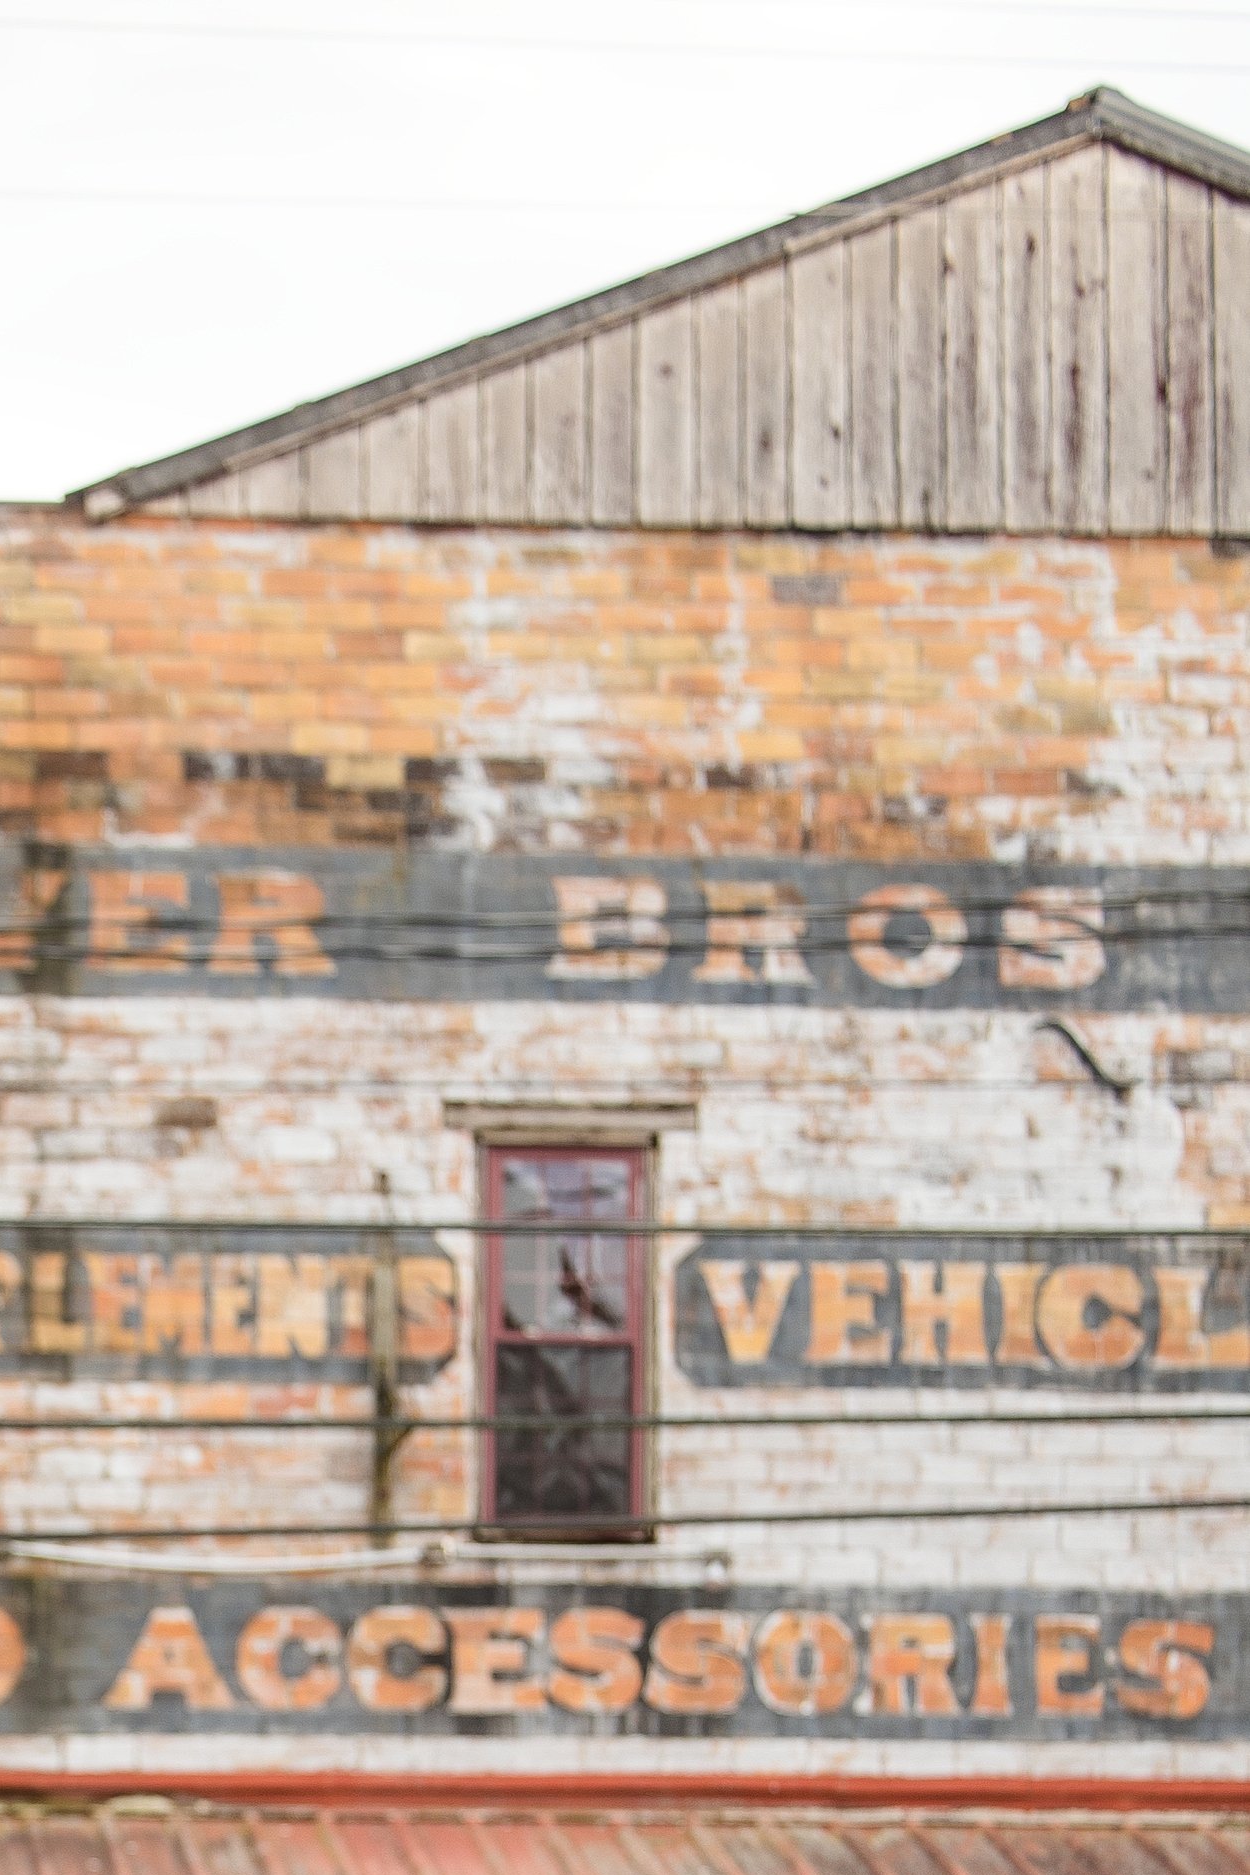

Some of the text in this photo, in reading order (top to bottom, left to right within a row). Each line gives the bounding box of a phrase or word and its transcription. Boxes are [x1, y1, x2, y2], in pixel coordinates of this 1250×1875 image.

[546, 874, 1108, 990] BROS
[699, 1259, 1250, 1371] VEHICL
[103, 1605, 1214, 1719] ACCESSORIES
